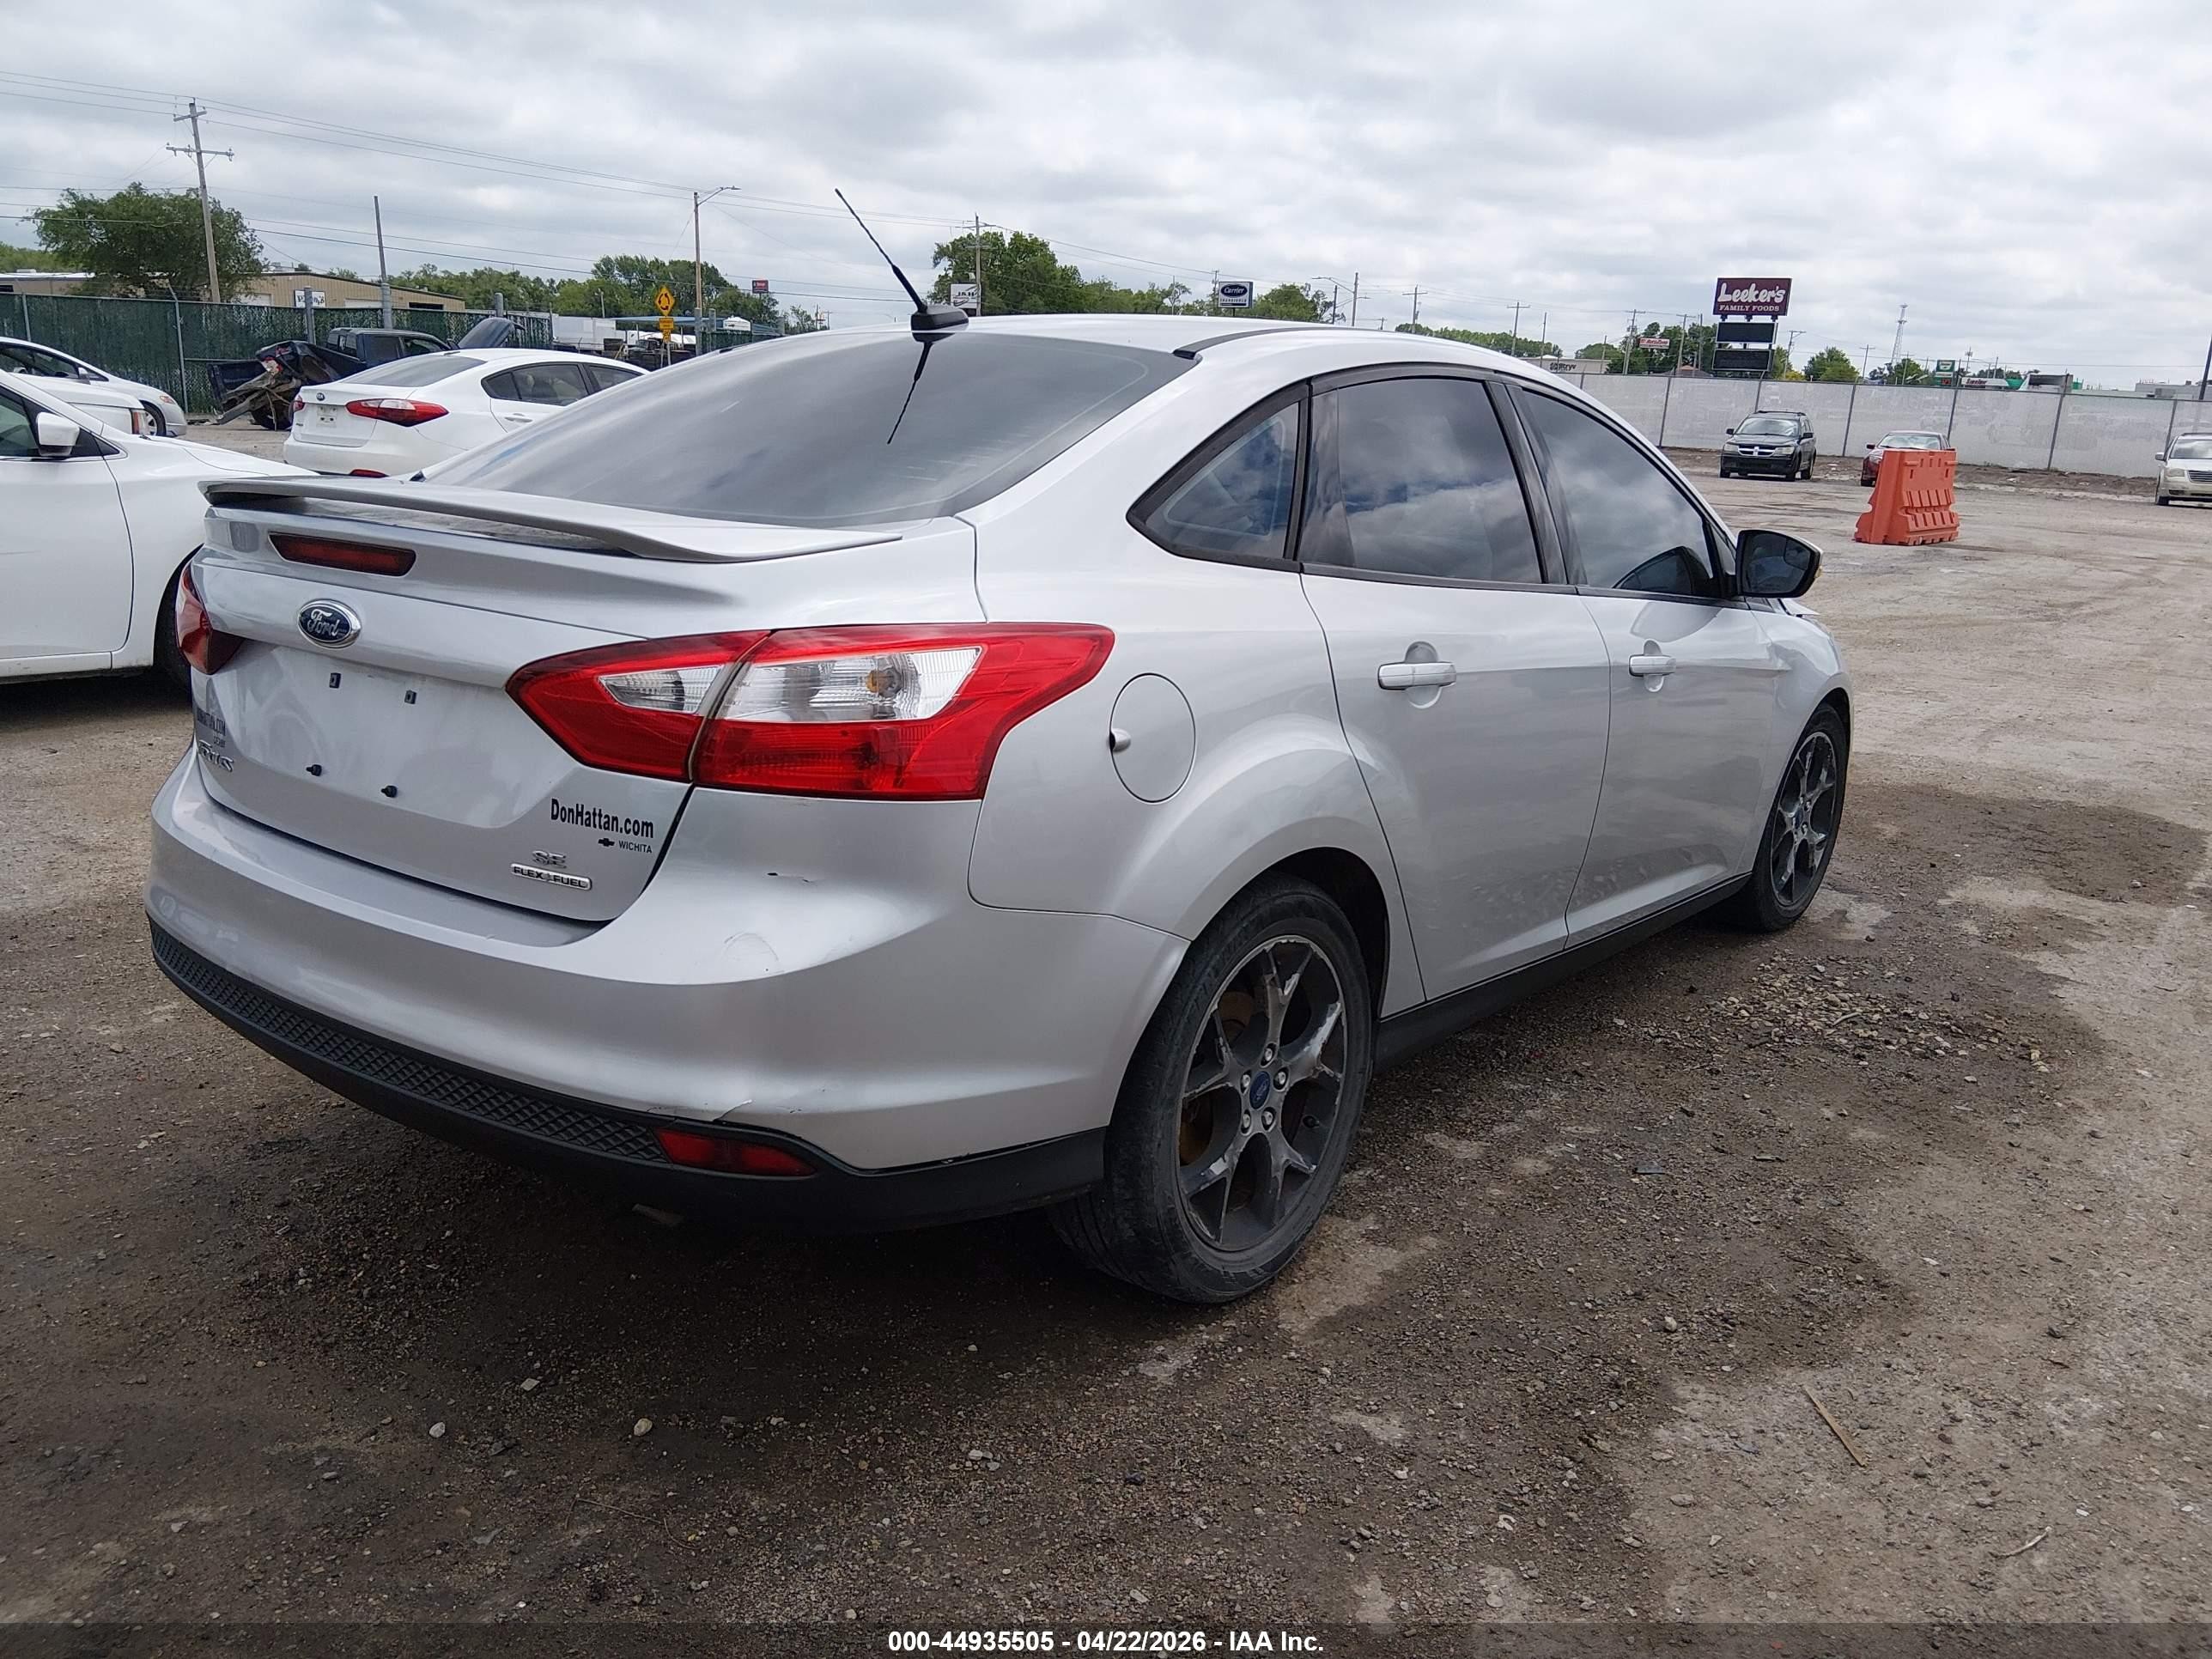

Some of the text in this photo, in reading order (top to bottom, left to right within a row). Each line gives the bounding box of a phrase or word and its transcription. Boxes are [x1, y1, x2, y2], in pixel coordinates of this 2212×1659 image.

[1717, 283, 1786, 303] Leeker's
[307, 609, 341, 637] Ford
[550, 798, 654, 839] DonHattan.com
[618, 840, 653, 854] WICHITA
[532, 850, 567, 869] SE
[514, 866, 588, 889] FLEX FUEL
